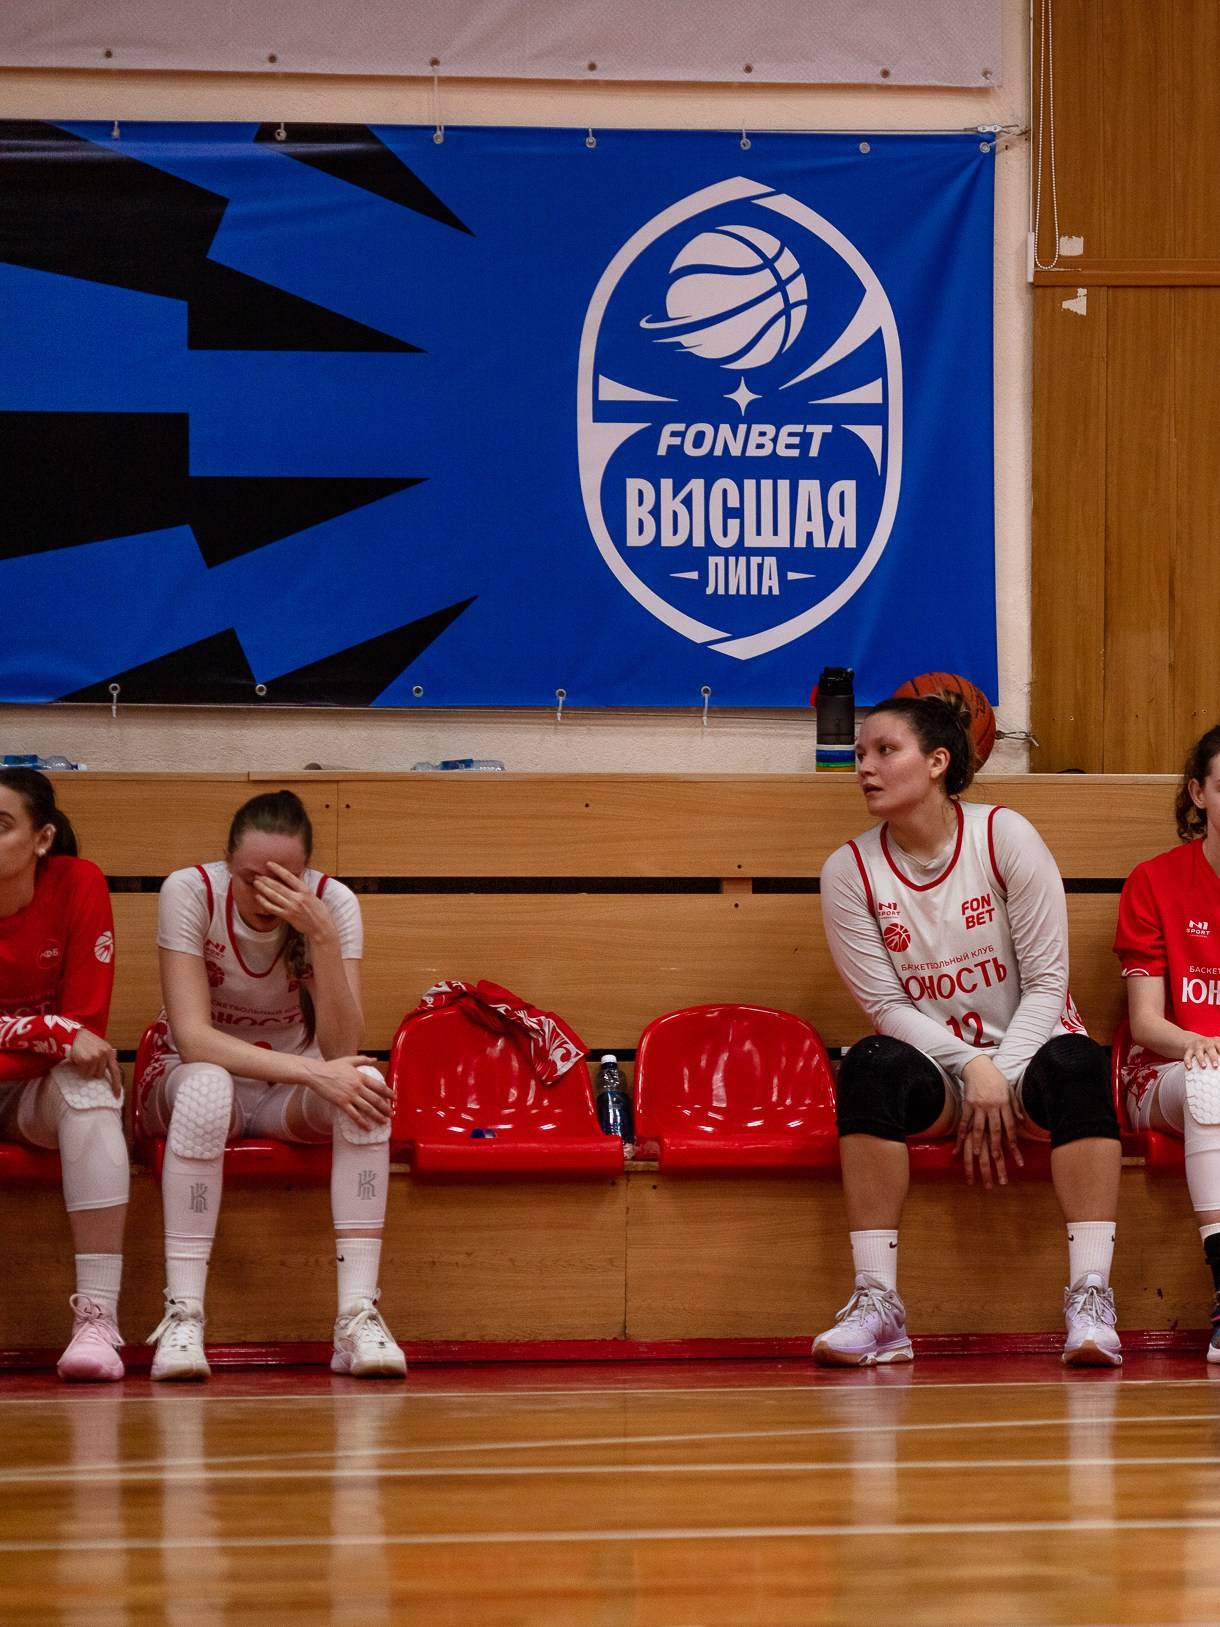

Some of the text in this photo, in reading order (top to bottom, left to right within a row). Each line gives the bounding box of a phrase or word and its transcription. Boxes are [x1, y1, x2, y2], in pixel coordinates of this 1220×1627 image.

[657, 423, 833, 457] FONBET
[625, 478, 857, 548] ВЫСШАЯ
[706, 556, 780, 595] ЛИГА
[961, 893, 991, 916] FON
[965, 907, 996, 930] BET
[1186, 928, 1210, 936] SPORT
[970, 945, 994, 959] КЛУБ
[945, 1011, 996, 1048] 12
